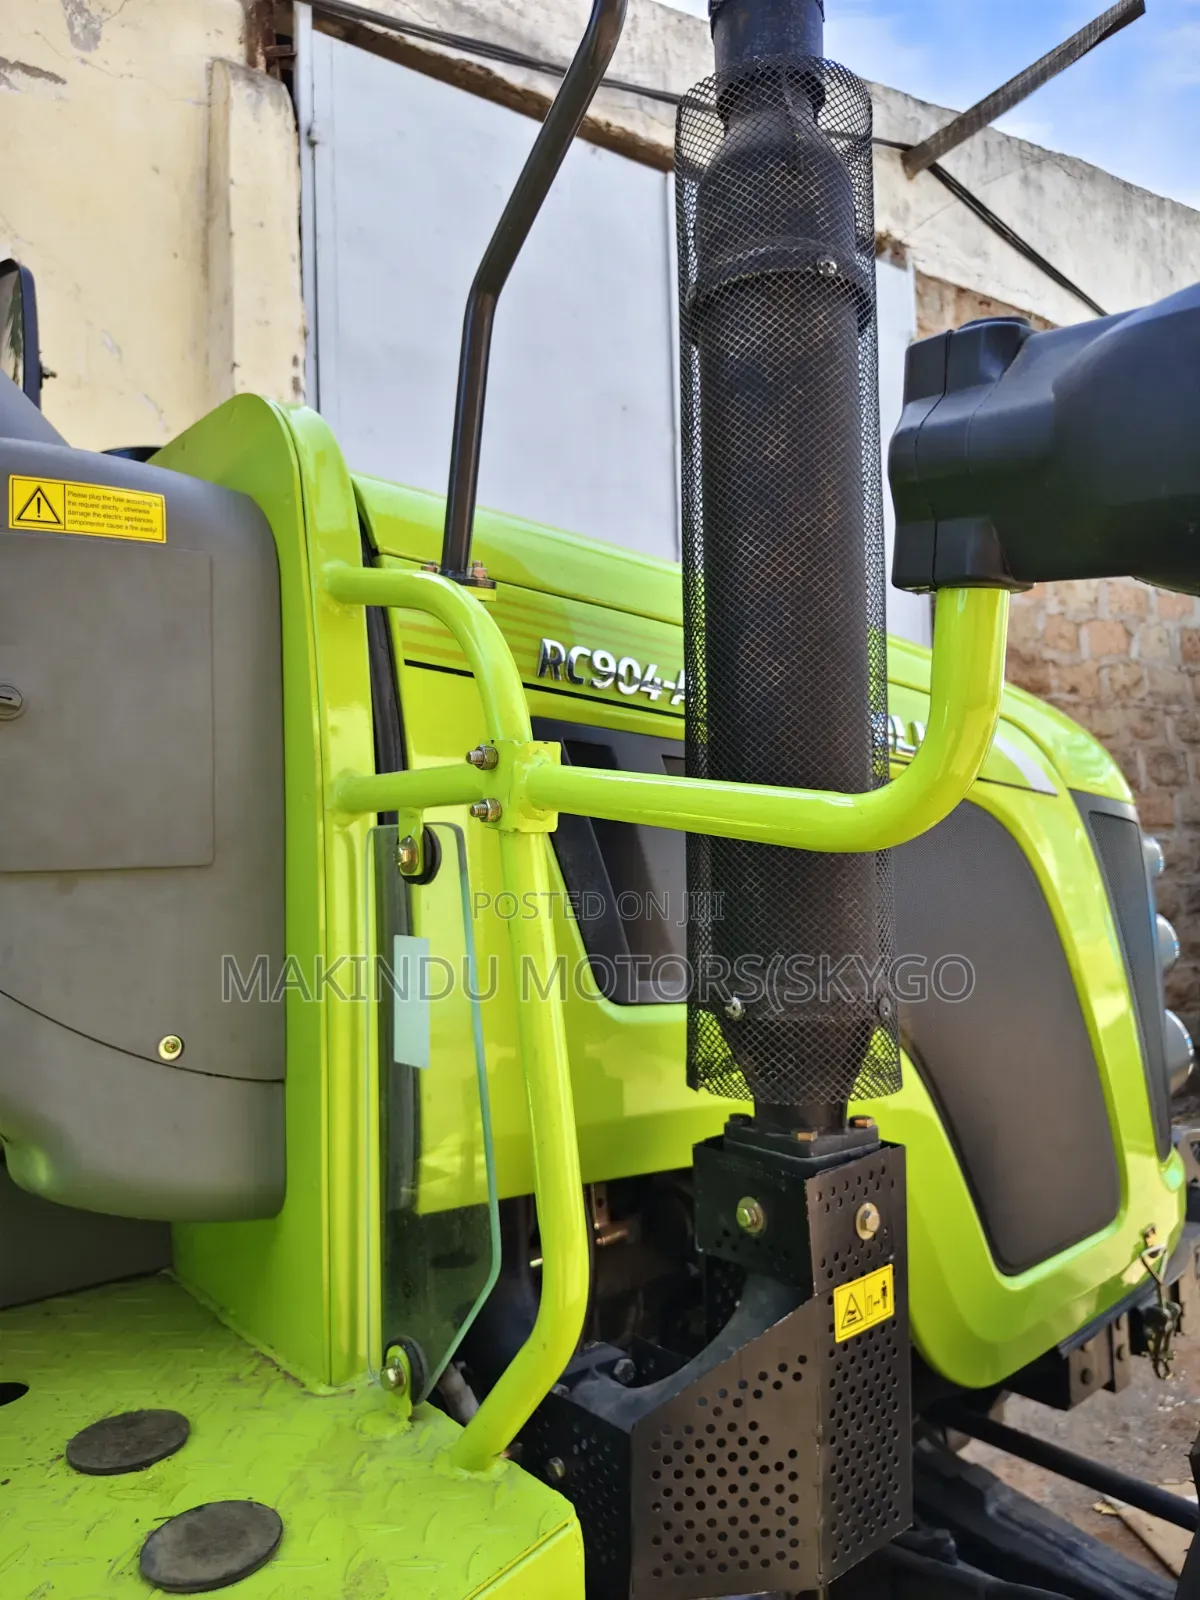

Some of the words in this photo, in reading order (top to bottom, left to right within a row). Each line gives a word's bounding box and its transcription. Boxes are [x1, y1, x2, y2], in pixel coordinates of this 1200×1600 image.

[67, 490, 88, 498] Please
[88, 494, 102, 502] plug
[112, 495, 125, 503] fuse
[126, 498, 153, 507] according
[67, 509, 91, 518] damage
[92, 511, 102, 519] the
[102, 513, 123, 521] electric
[124, 515, 153, 524] appliances
[106, 522, 124, 530] cause
[139, 526, 158, 534] easily!
